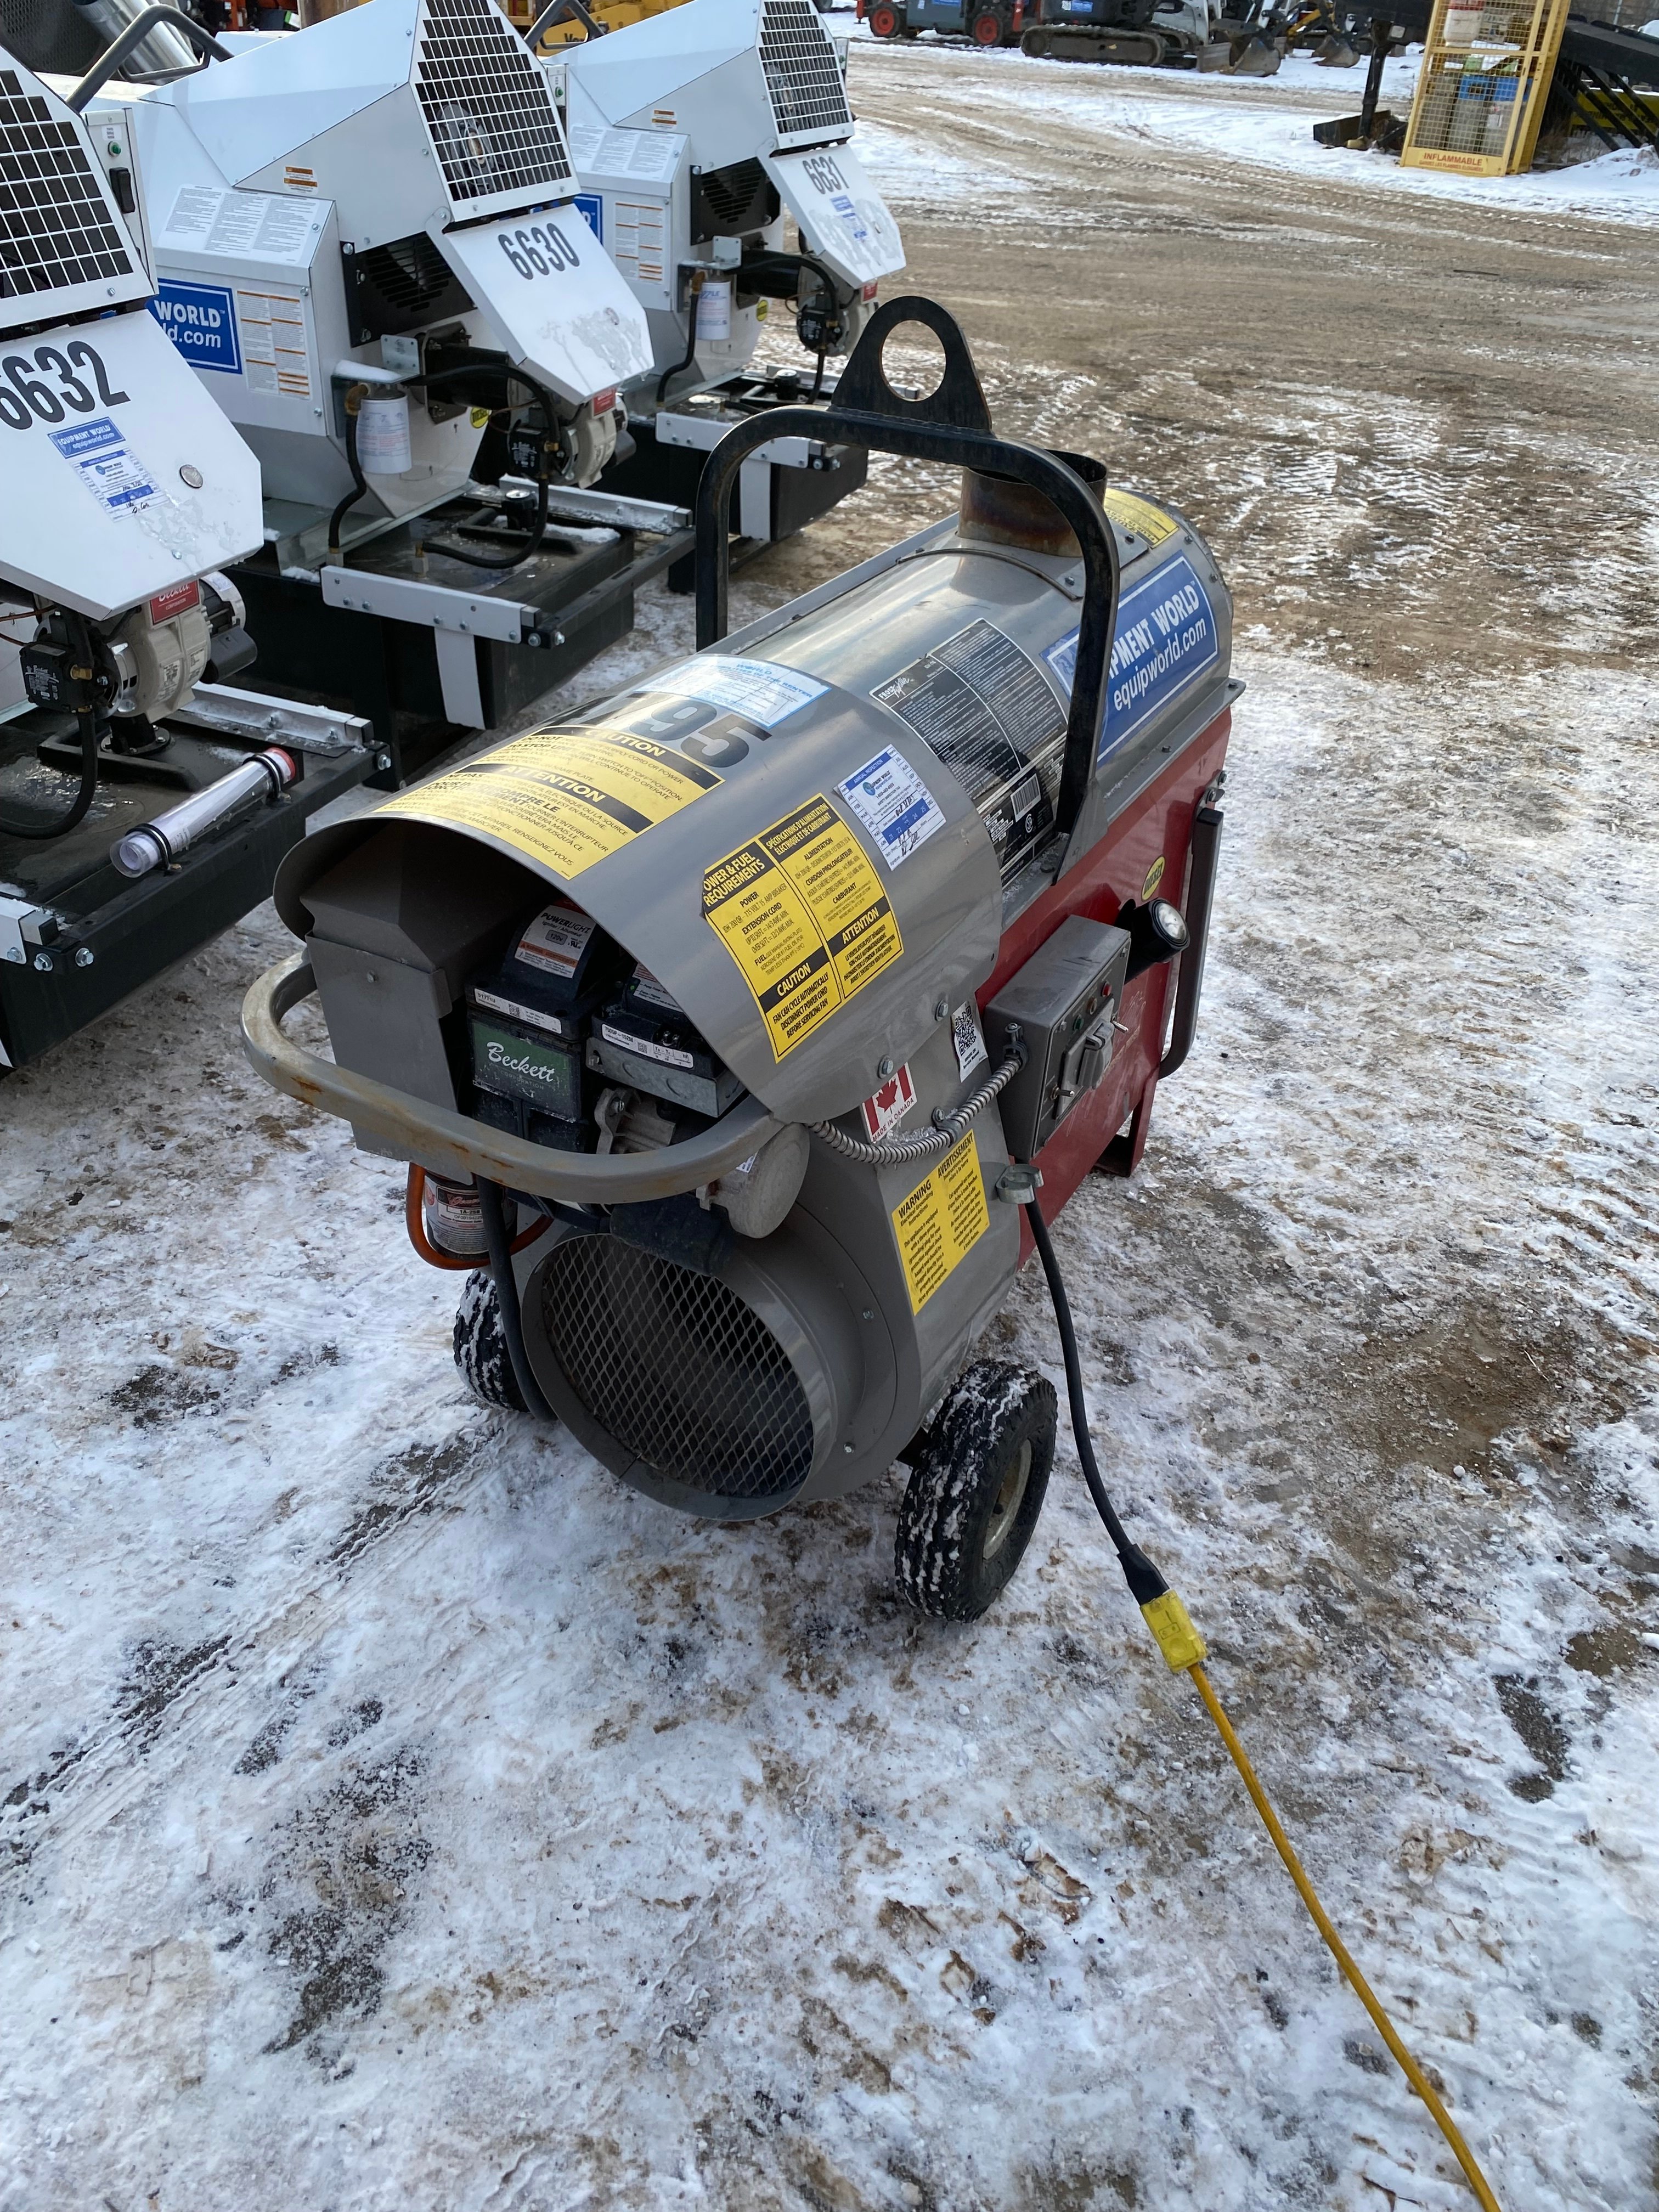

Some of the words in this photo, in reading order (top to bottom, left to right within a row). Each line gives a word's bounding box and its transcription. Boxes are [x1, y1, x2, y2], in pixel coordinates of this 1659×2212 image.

[1424, 153, 1483, 165] INFLAMMABLE
[803, 156, 850, 194] 6631
[498, 223, 580, 280] 6630
[58, 431, 89, 445] EQUIPMENT
[89, 424, 111, 438] WORLD
[72, 432, 115, 449] equipworld.com
[1151, 584, 1200, 635] WORLD
[1113, 617, 1207, 712] equipworld.com
[782, 682, 813, 698] RENTER
[585, 728, 667, 758] CAUTION
[596, 755, 625, 770] SWITCH
[628, 754, 649, 765] CORD
[659, 768, 684, 785] POWER
[853, 771, 866, 783] ANNUAL
[865, 758, 883, 774] INSPECTION
[500, 765, 606, 803] ATTENTION
[596, 760, 632, 778] CONTINUE
[630, 775, 641, 783] TO
[640, 780, 672, 800] OPERATE
[543, 802, 561, 813] LE
[567, 805, 579, 814] EN
[583, 806, 594, 815] OU
[602, 816, 628, 837] SOURCE
[808, 811, 832, 833] CARBURANT
[481, 815, 513, 831] APPAREIL
[512, 827, 556, 854] RENSEIGNEZ
[554, 850, 575, 866] VOUS
[496, 805, 546, 830] FONCTIONNER
[573, 843, 585, 851] CE
[525, 802, 557, 821] TOURNER
[555, 816, 609, 853] L'INTERRUPTEUR
[551, 822, 572, 836] MAIS
[571, 832, 580, 840] LE
[804, 837, 834, 861] ALIMENTATION
[703, 869, 730, 891] OWER
[725, 864, 735, 875] &
[731, 851, 757, 871] FUEL
[703, 858, 766, 907] REQUIREMENTS
[805, 870, 824, 887] CORDON
[822, 848, 854, 876] PROLONGATEUR
[739, 891, 759, 907] POWER
[764, 893, 774, 903] AMP
[771, 882, 787, 897] BREAKER
[832, 882, 857, 904] CARBURANT
[540, 912, 592, 934] POWERLIGHT
[741, 911, 770, 934] EXTENSION
[768, 901, 782, 915] CORD
[842, 906, 880, 945] ATTENTION
[550, 933, 563, 942] 120v
[751, 943, 762, 953] OVER
[754, 953, 767, 966] FUEL
[776, 962, 812, 996] CAUTION
[772, 1014, 782, 1024] FAN
[781, 1005, 791, 1017] CAN
[789, 996, 802, 1012] CYCLE
[800, 972, 830, 1002] AUTOMATICALLY
[781, 1006, 805, 1030] DISCONNECT
[804, 995, 819, 1012] POWER
[818, 986, 828, 1000] CORD
[786, 1022, 802, 1039] BEFORE
[800, 1005, 823, 1029] SERVICING
[487, 1042, 555, 1082] Beckett
[501, 1070, 544, 1090] CORPORATION
[872, 1125, 887, 1142] MADE
[894, 1098, 914, 1119] CANADA
[937, 1131, 973, 1179] AVERTISSEMENT
[943, 1158, 961, 1181] Instructions
[898, 1179, 932, 1219] WARNING
[900, 1207, 916, 1226] Electrical
[915, 1189, 933, 1211] Grounding
[908, 1203, 928, 1226] Instructions
[910, 1224, 924, 1243] appliance
[924, 1207, 938, 1226] equipped
[910, 1253, 925, 1273] protection
[924, 1242, 935, 1257] against
[934, 1233, 942, 1245] shock
[926, 1260, 936, 1275] directly
[928, 1248, 938, 1261] should
[930, 1261, 944, 1280] grounded
